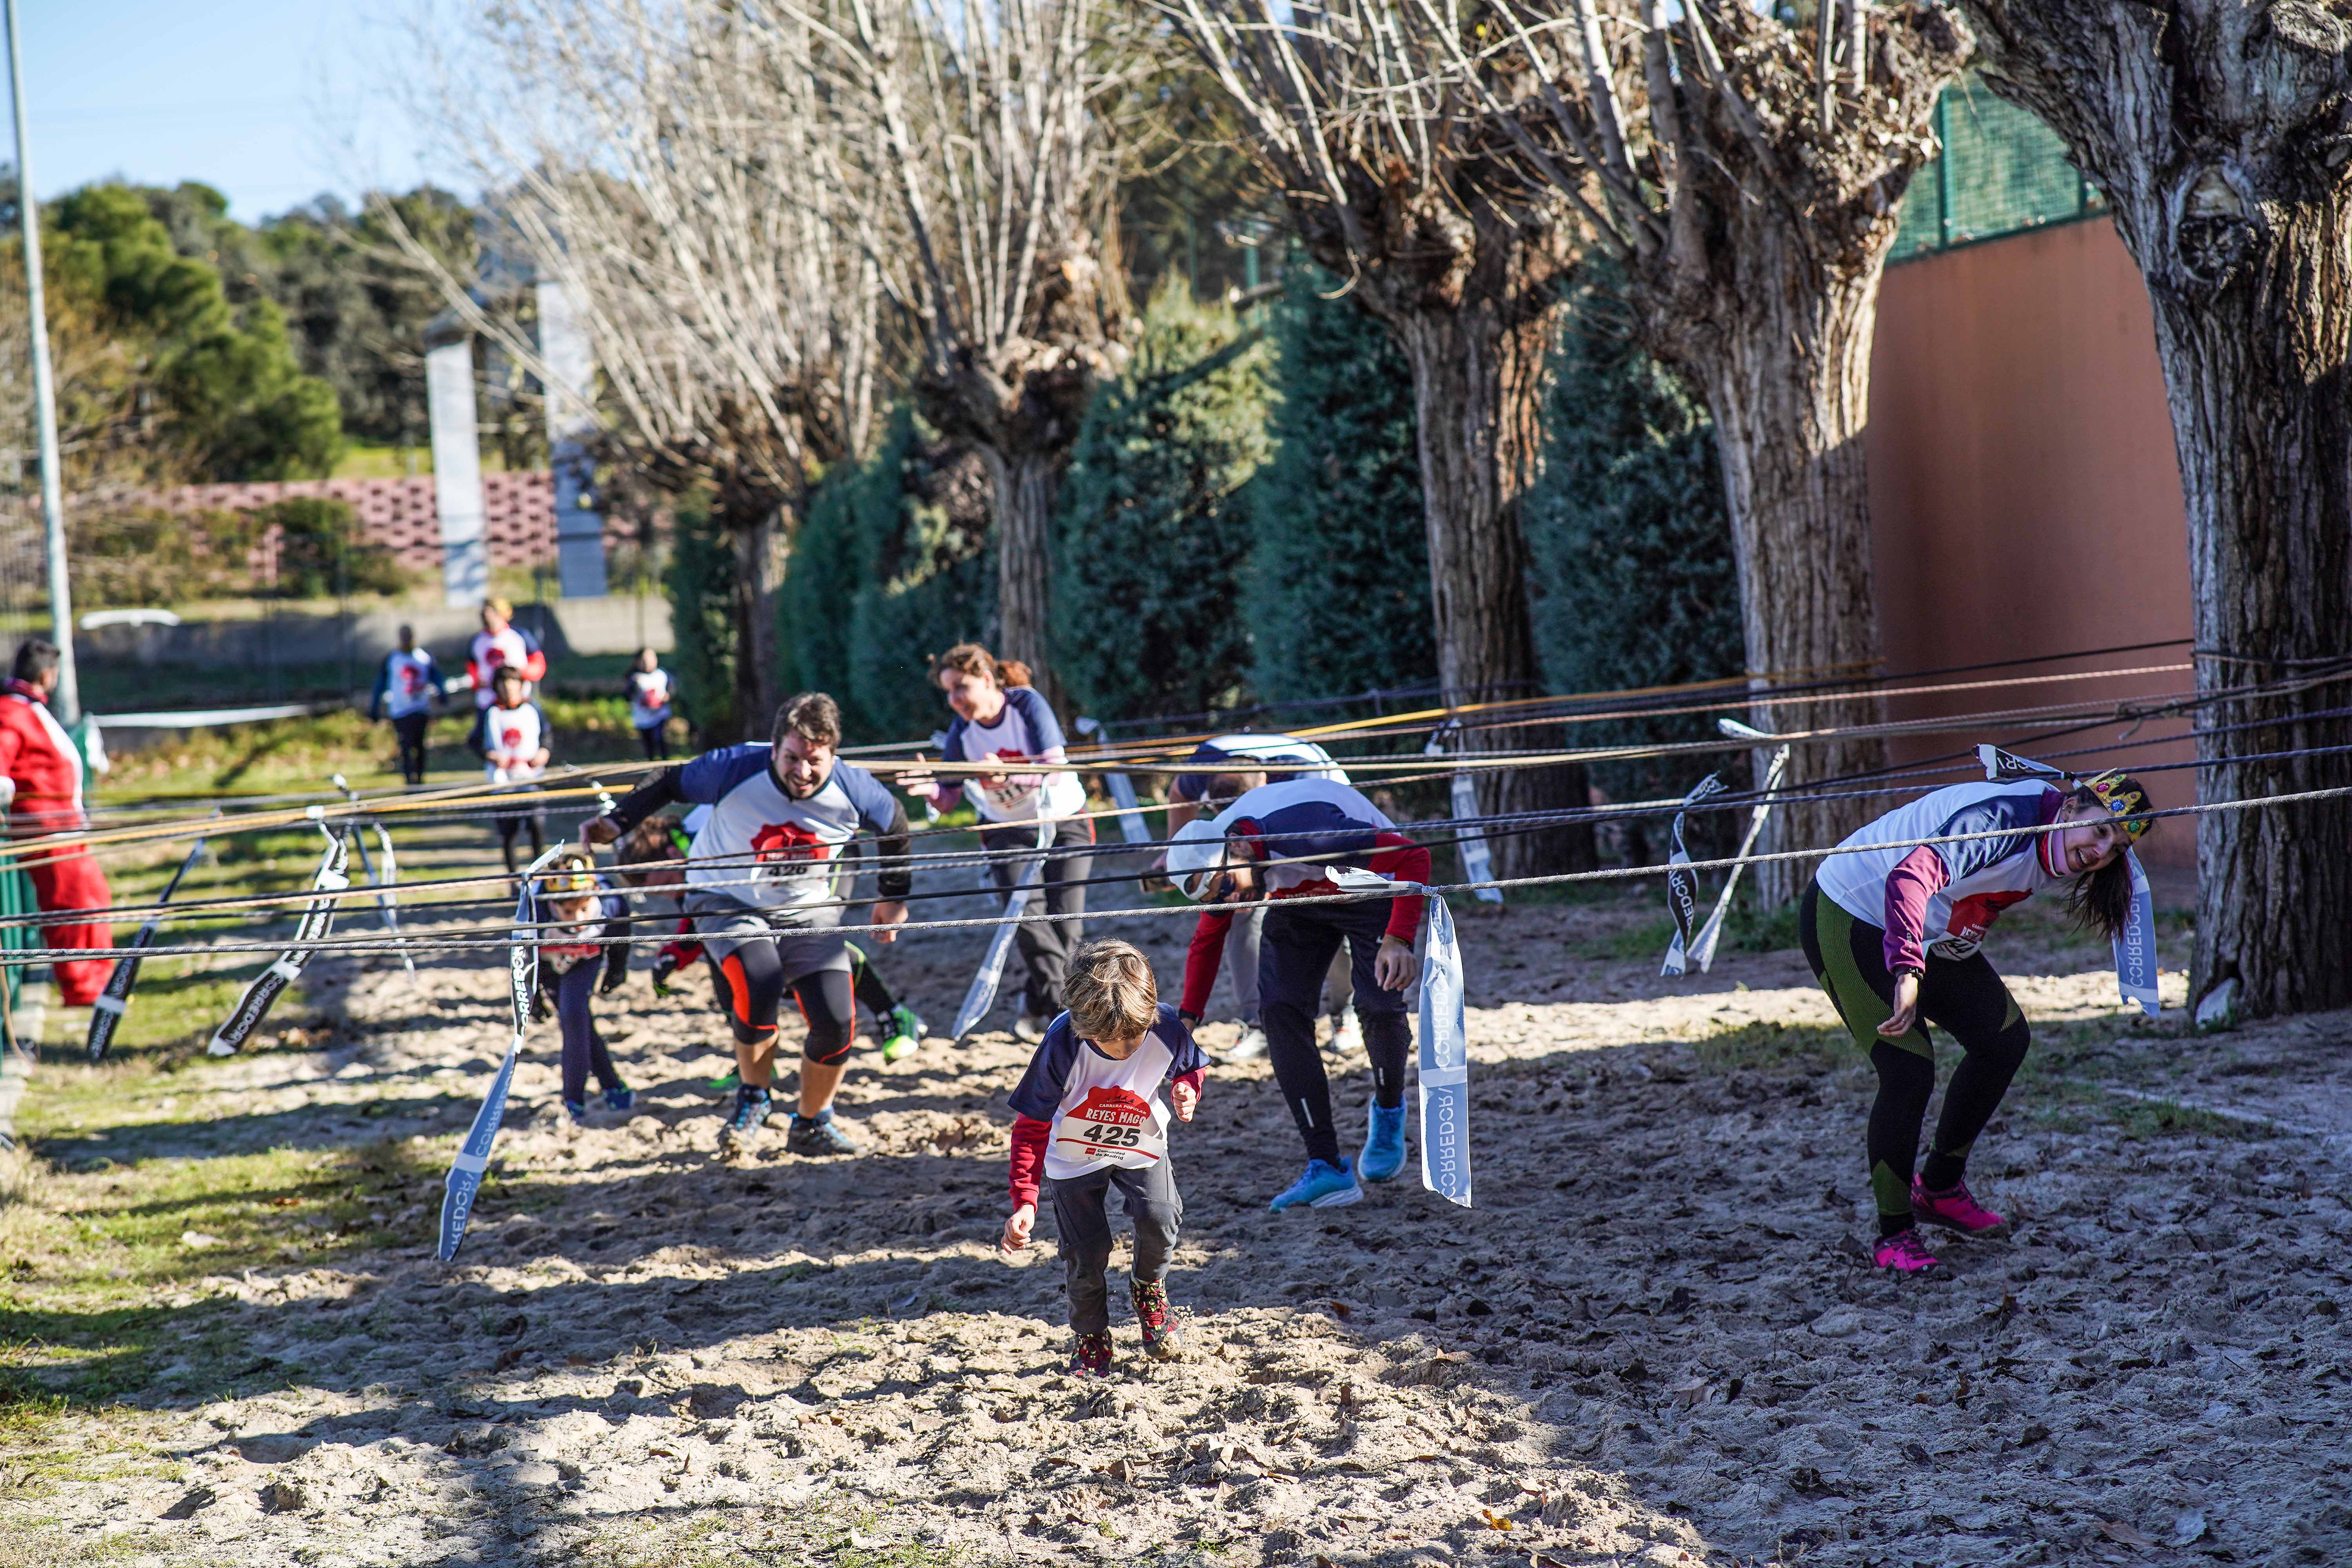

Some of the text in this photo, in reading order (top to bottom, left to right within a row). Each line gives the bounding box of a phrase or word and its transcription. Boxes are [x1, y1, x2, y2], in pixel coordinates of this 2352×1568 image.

[1085, 1108, 1146, 1125] REYES MAGO
[1123, 1105, 1147, 1114] POPULAR
[1083, 1124, 1141, 1147] 425
